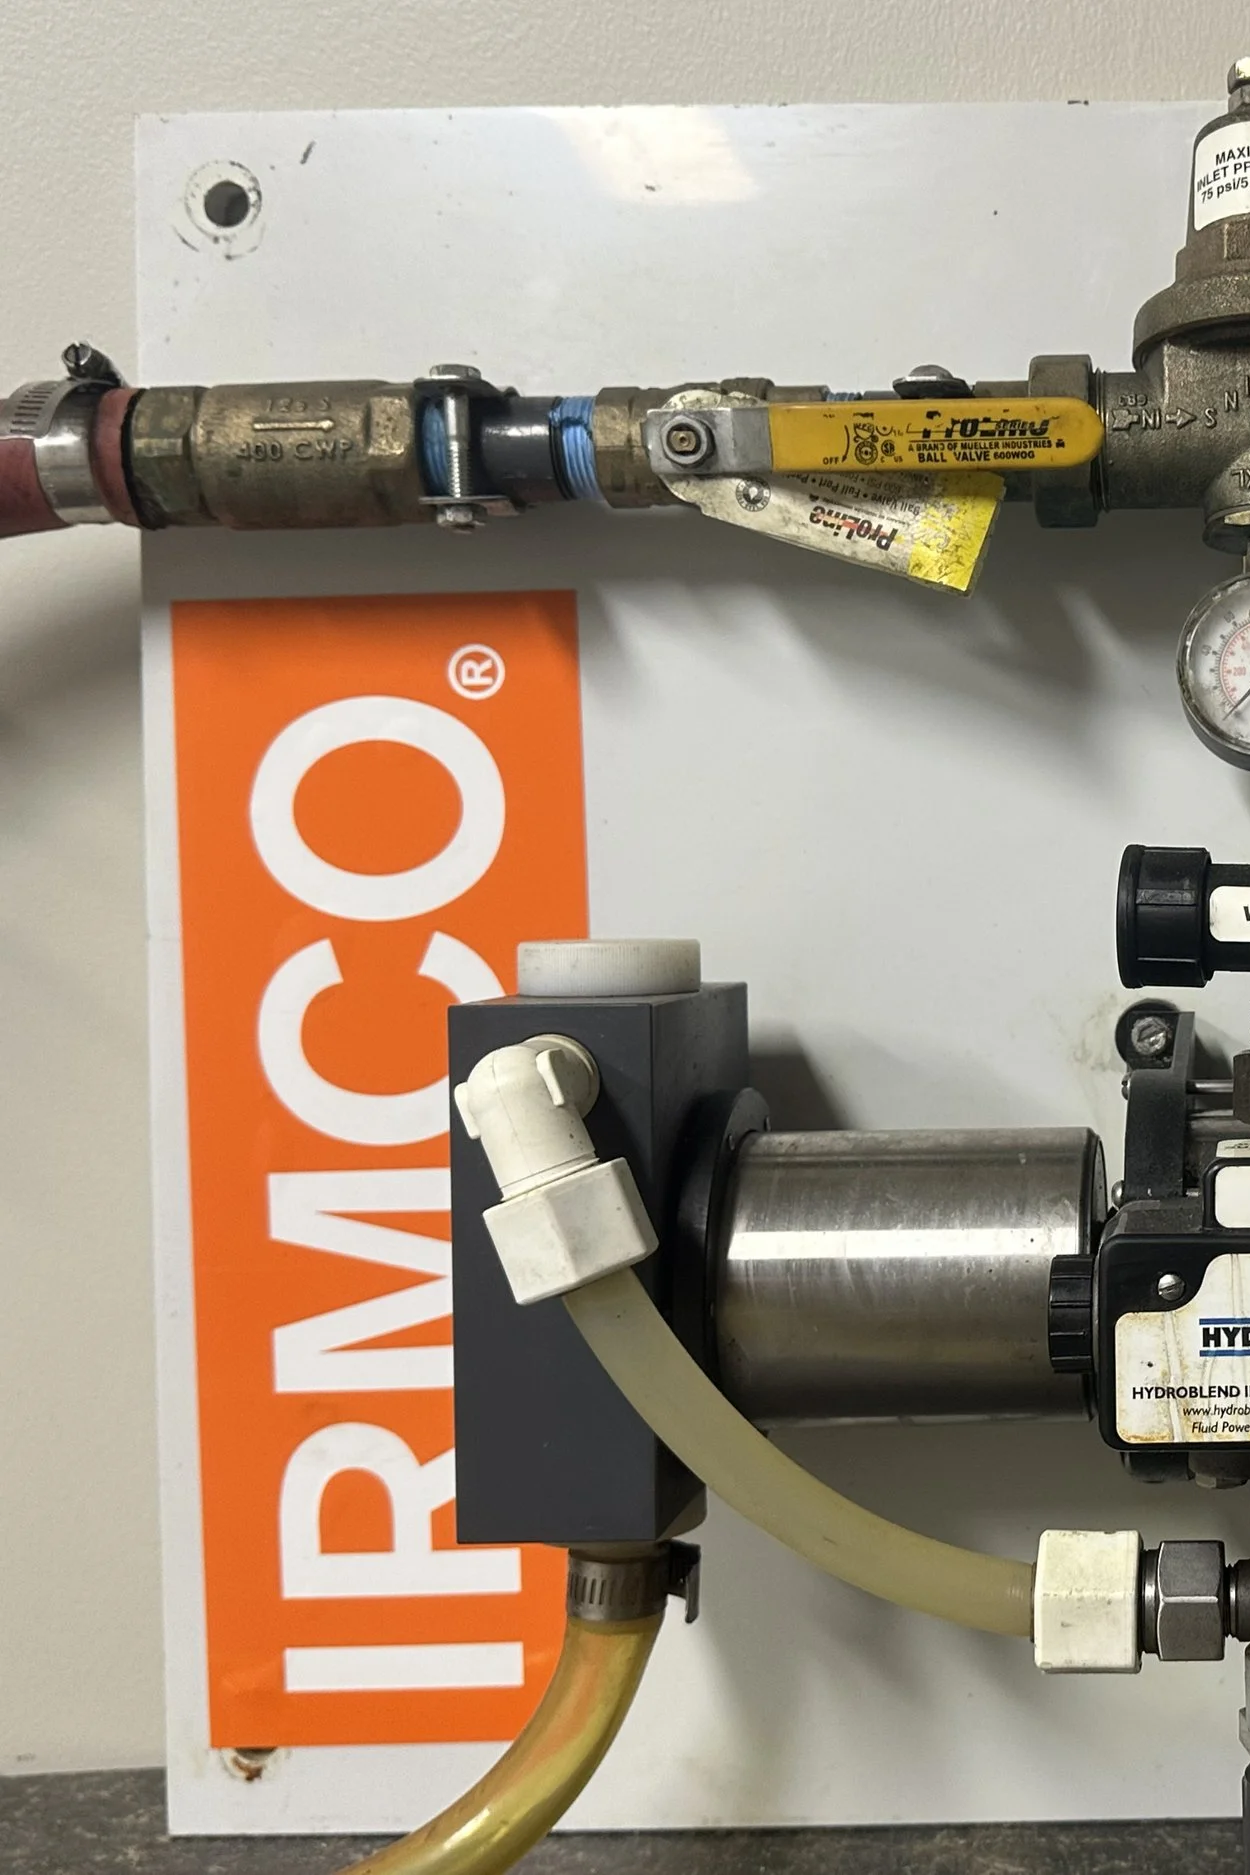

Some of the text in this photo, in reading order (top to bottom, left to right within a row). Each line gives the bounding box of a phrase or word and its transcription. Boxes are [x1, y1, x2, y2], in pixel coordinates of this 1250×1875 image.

[1197, 165, 1230, 192] INLET
[1201, 187, 1214, 204] 75
[1141, 410, 1162, 430] IN
[293, 438, 354, 461] CWP
[916, 442, 945, 452] BRAND
[947, 442, 958, 451] OF
[961, 441, 1000, 450] MUELLER
[1002, 440, 1052, 449] INDUSTRIES
[823, 457, 839, 465] OFF
[918, 452, 947, 463] BALL
[954, 451, 991, 462] VALVE
[818, 477, 840, 494] Port
[841, 485, 861, 499] Full
[871, 492, 901, 511] Valve
[900, 500, 921, 517] Ball
[809, 505, 899, 552] ProLine
[1132, 1384, 1241, 1400] HYDROBLEND
[1192, 1420, 1219, 1433] Fluid
